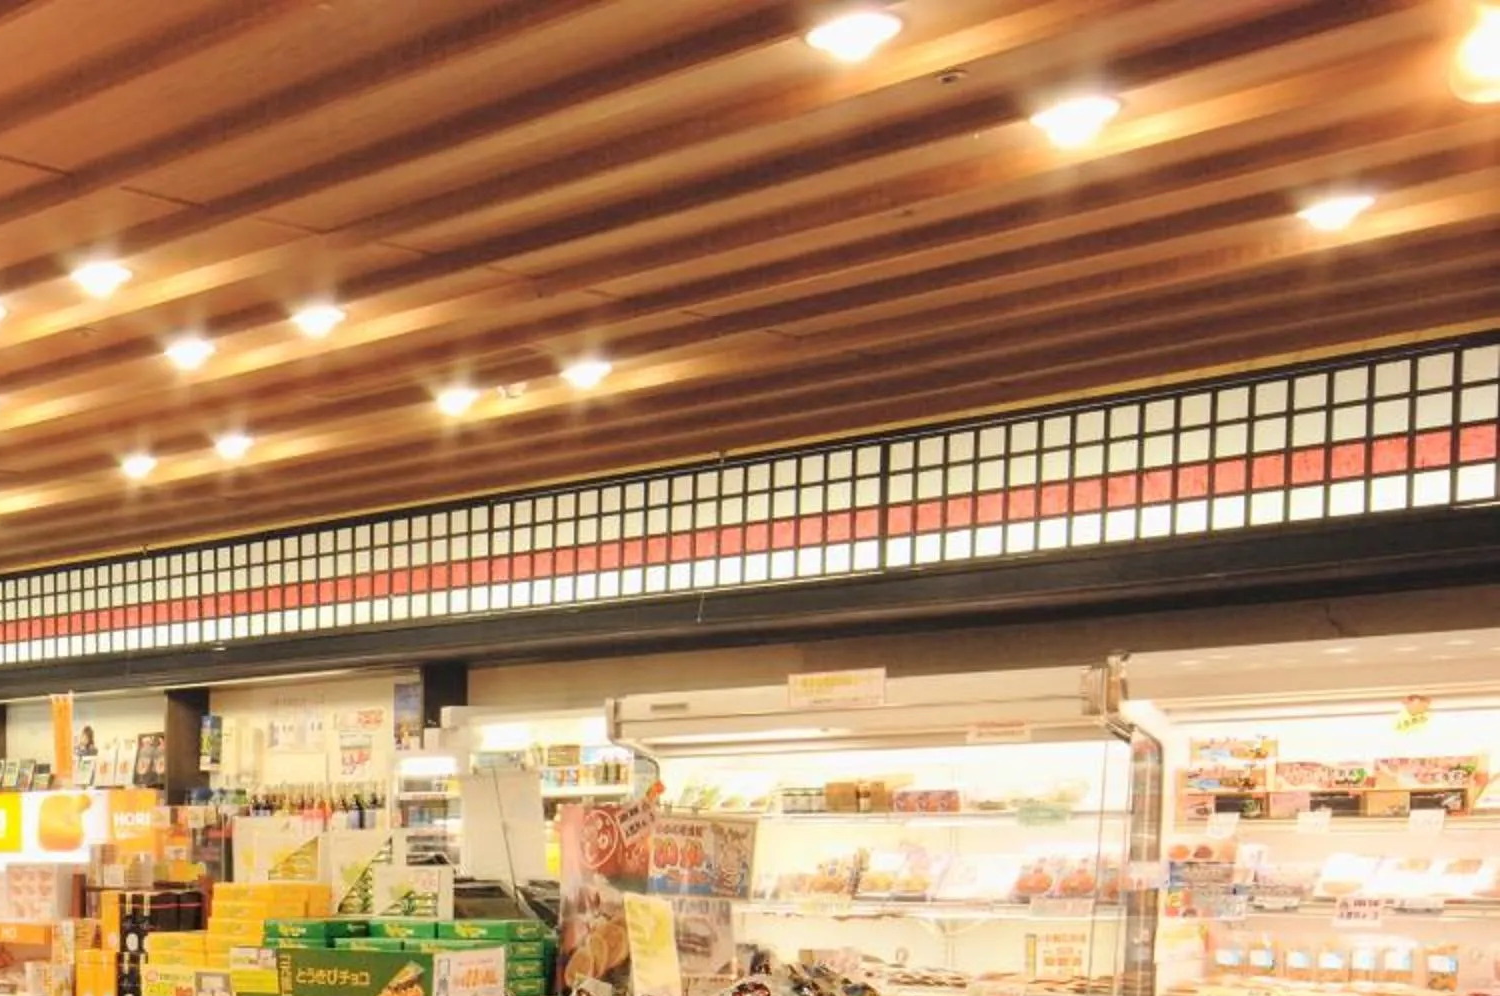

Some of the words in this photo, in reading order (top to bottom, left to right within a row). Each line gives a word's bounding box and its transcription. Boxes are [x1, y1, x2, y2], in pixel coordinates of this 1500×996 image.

[296, 967, 371, 985] とうきびチョコ
